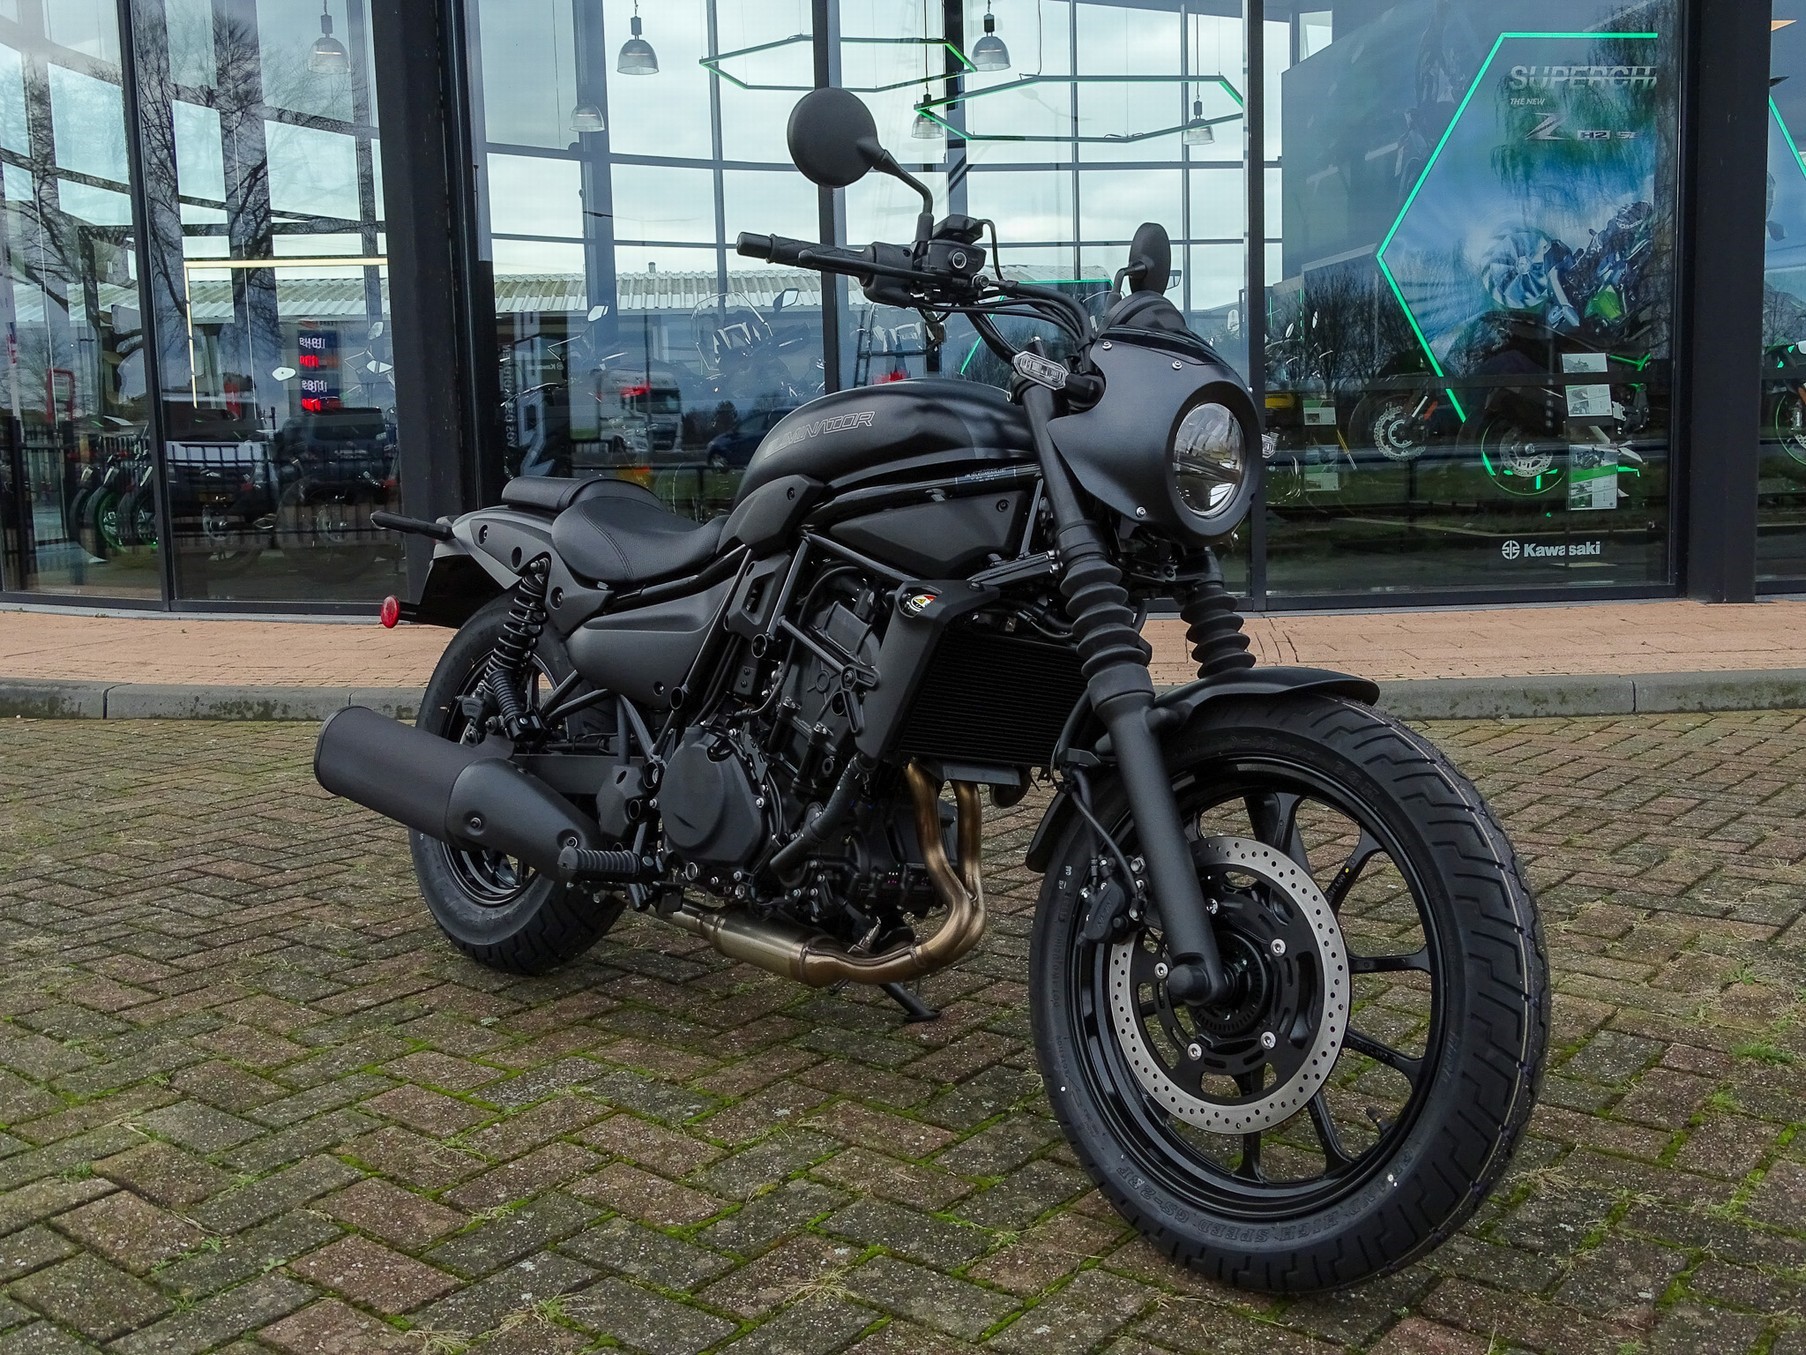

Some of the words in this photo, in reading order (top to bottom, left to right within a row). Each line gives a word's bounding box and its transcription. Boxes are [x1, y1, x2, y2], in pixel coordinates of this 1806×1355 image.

[1509, 97, 1525, 106] THE
[1526, 97, 1545, 106] NEW
[1523, 541, 1601, 557] Kawasaki
[1197, 1216, 1270, 1244] SPEED
